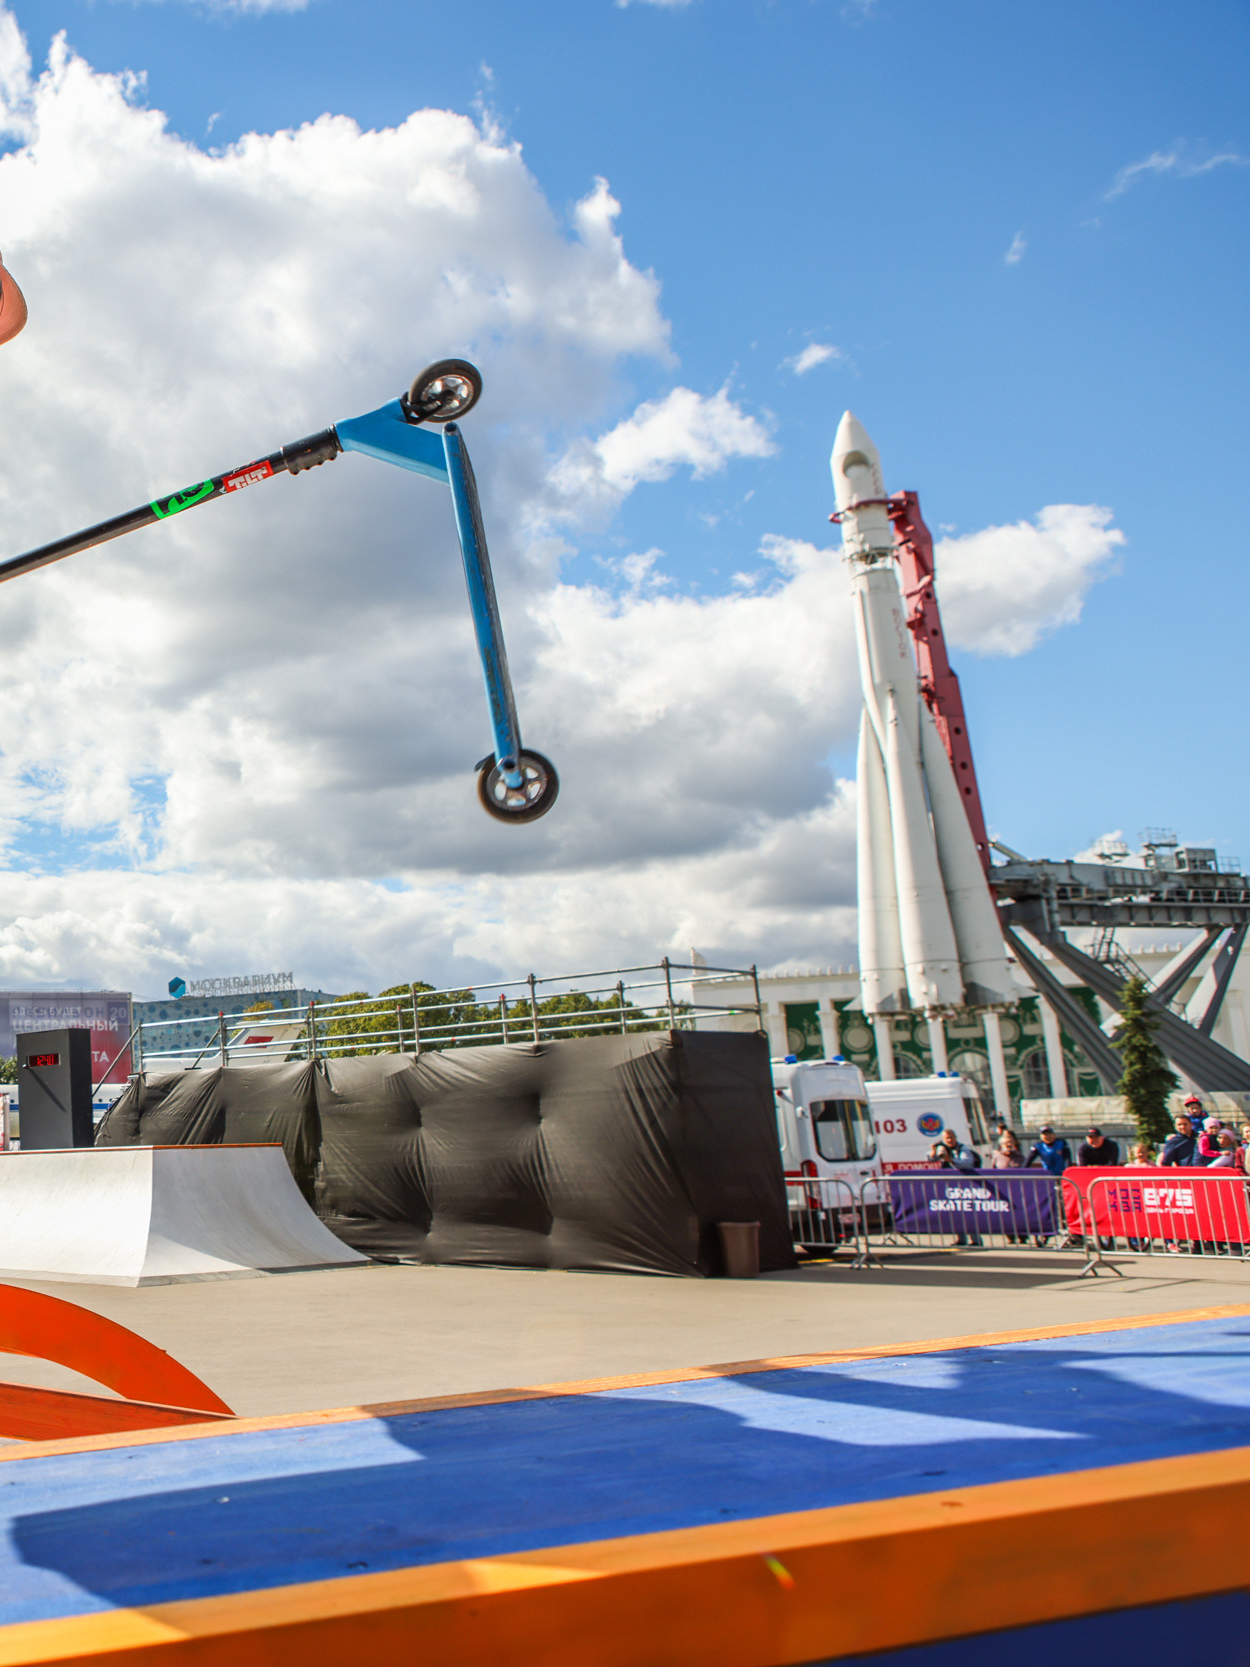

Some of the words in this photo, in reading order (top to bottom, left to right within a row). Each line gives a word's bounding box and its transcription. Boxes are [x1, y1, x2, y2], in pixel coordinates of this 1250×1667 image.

[190, 971, 294, 992] МОСКВАРИУМ
[875, 1118, 907, 1134] 103
[945, 1187, 991, 1199] GRAND
[929, 1199, 973, 1211] SKATE
[974, 1200, 1010, 1212] TOUR
